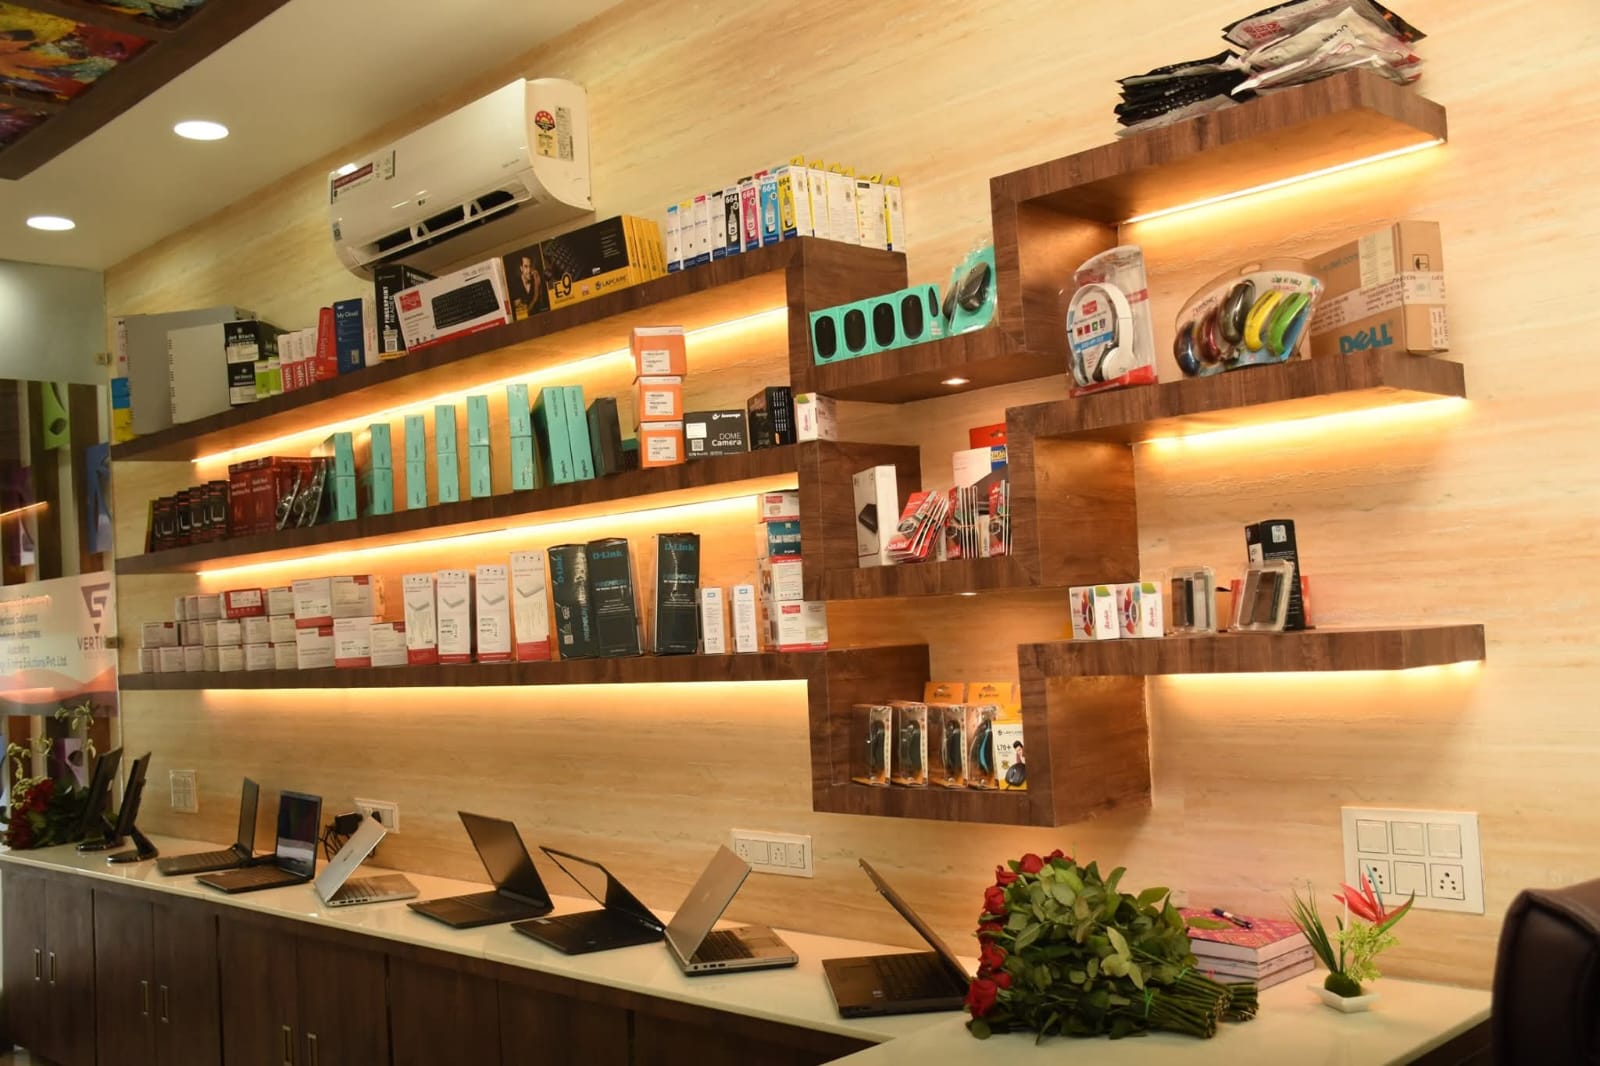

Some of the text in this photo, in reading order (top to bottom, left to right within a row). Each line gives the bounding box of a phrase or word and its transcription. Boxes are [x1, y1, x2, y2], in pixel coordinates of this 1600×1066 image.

[762, 183, 776, 193] 664
[725, 195, 738, 204] 664
[742, 189, 755, 200] 664
[554, 273, 572, 299] E9
[1340, 323, 1393, 354] DELL
[719, 432, 741, 440] DOME
[664, 543, 694, 551] D-Link
[592, 550, 623, 560] D-Link
[77, 635, 106, 651] VERTI
